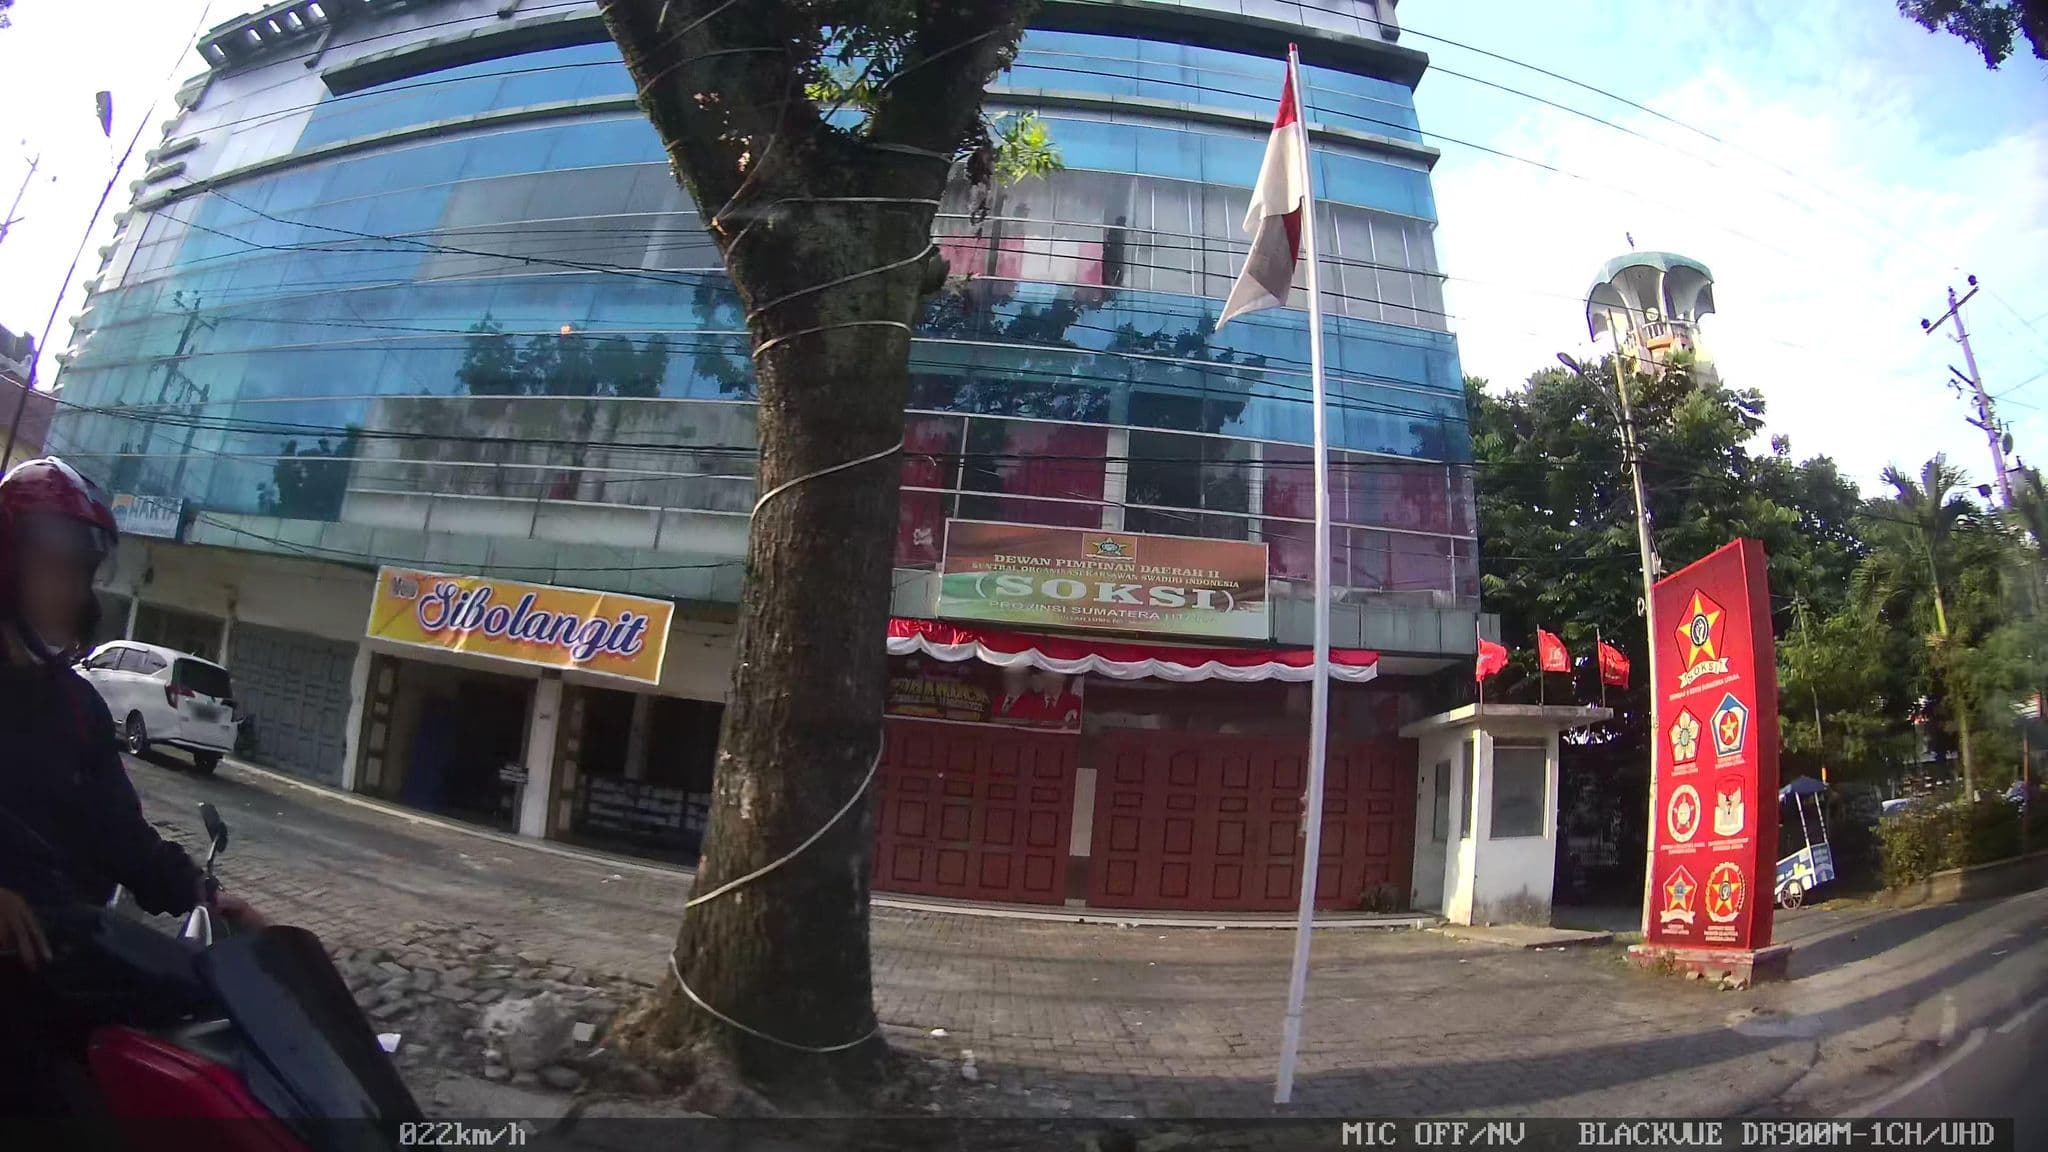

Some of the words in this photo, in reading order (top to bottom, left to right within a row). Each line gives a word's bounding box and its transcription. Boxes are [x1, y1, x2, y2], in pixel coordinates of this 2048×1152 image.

[993, 554, 1051, 566] DEWAN
[1055, 558, 1135, 572] PIMPINAN
[1140, 564, 1203, 578] DAERAH
[1185, 577, 1240, 589] INDONESIA
[989, 600, 1067, 614] PROVINSI
[1071, 605, 1161, 621] SUMATERA
